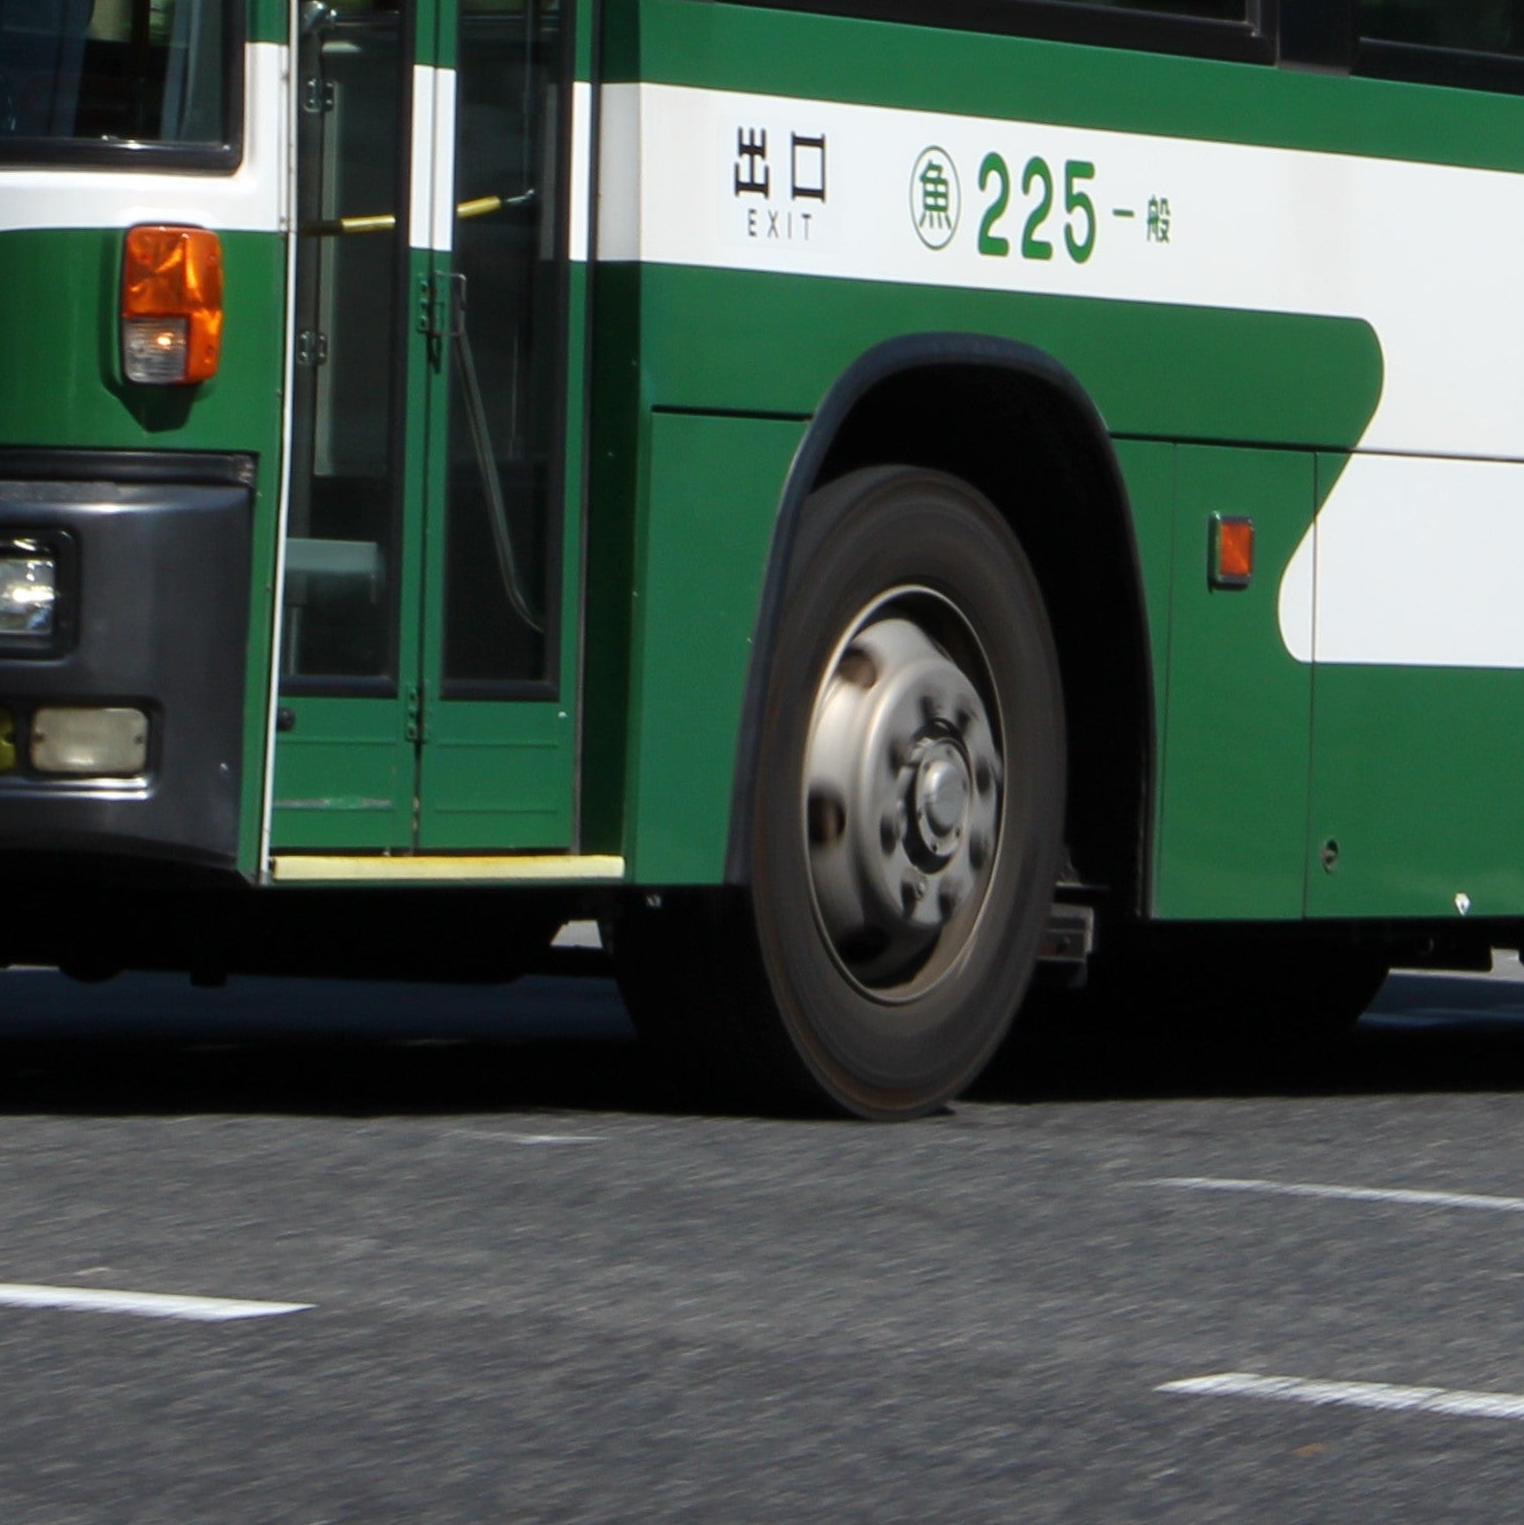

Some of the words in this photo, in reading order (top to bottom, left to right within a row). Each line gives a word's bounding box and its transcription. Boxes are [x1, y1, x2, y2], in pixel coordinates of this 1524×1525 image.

[733, 126, 828, 204] 出口
[747, 208, 814, 242] EXIT
[977, 151, 1097, 264] 225
